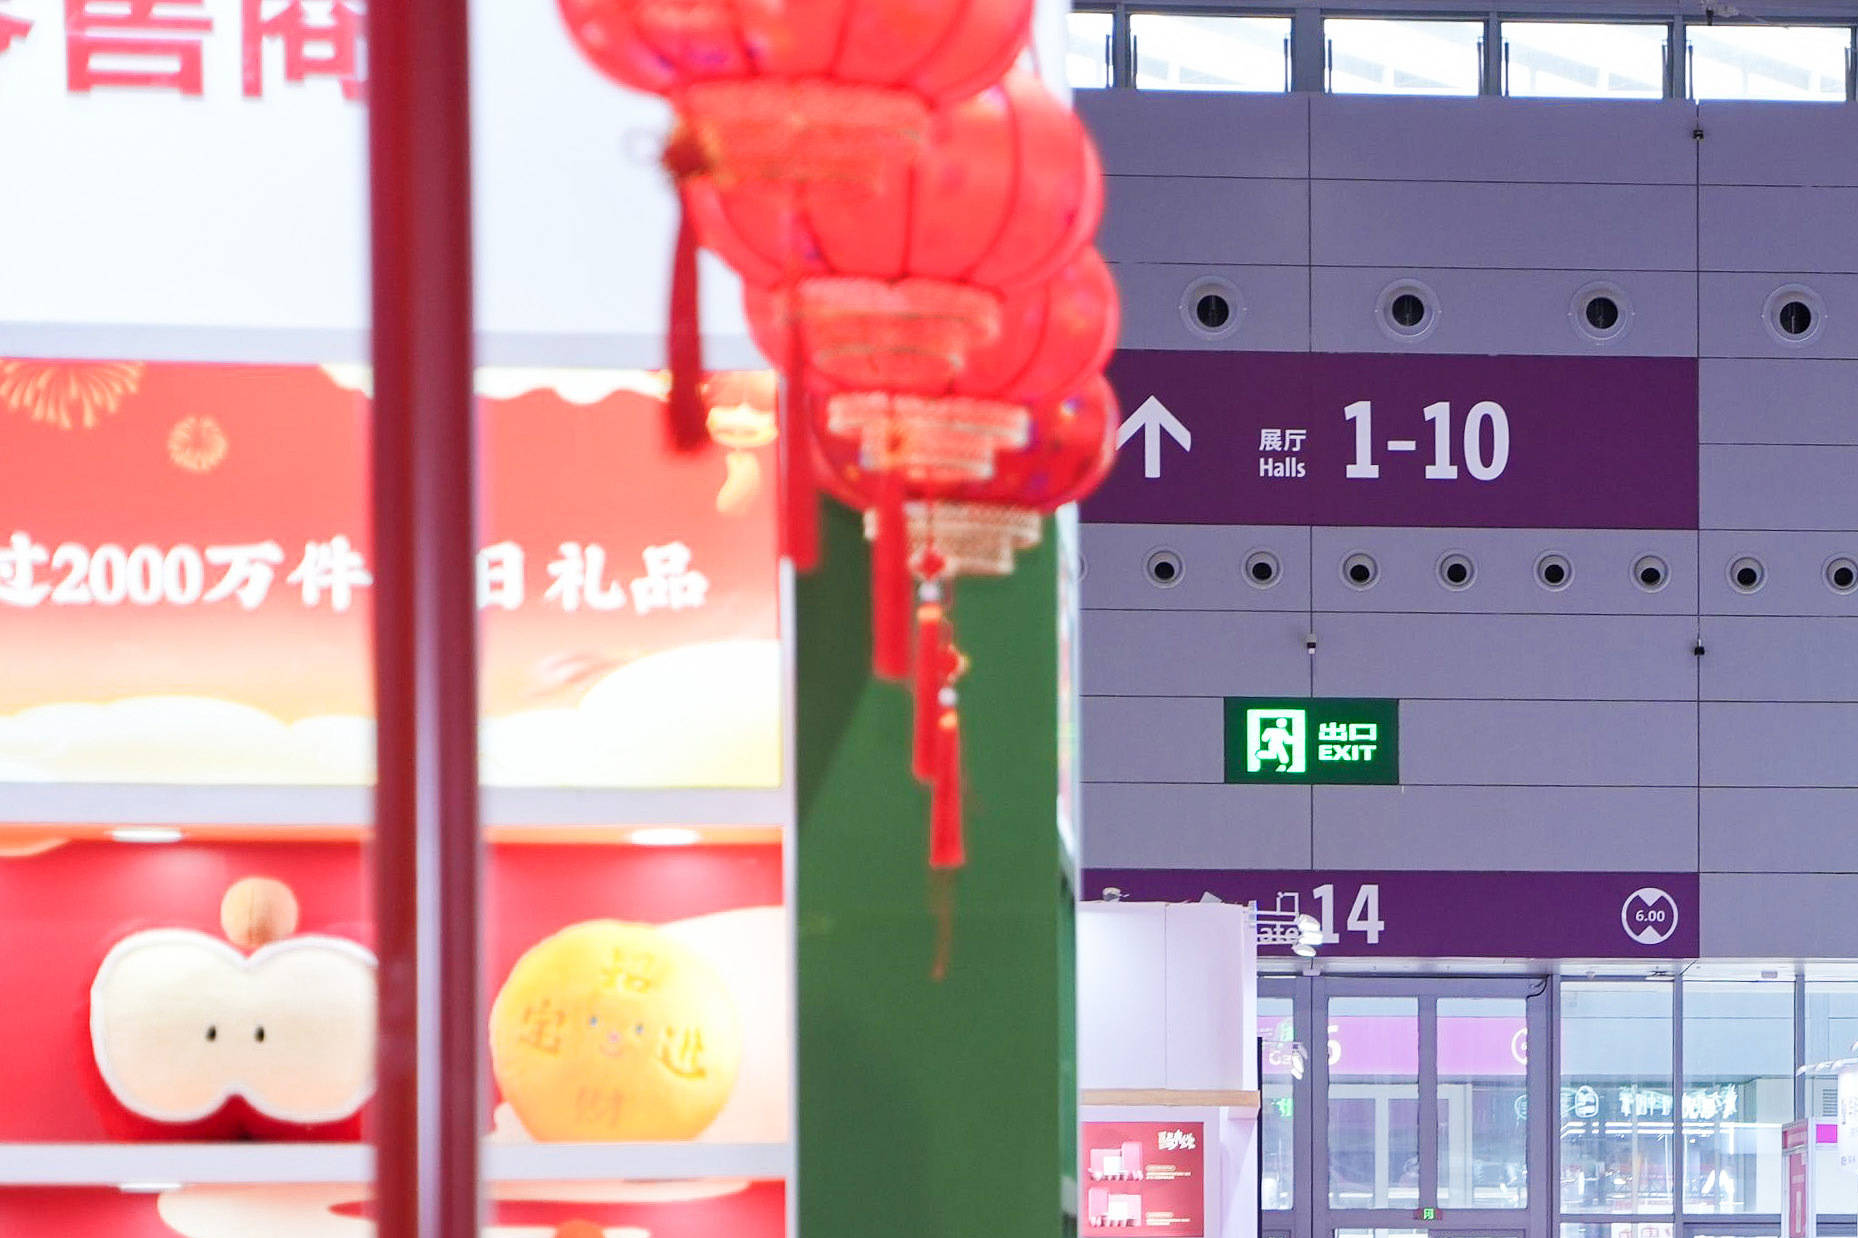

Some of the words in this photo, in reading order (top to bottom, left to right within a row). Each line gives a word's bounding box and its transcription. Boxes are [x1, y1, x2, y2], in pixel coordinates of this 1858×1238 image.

[1259, 428, 1308, 451] 展厅
[1343, 400, 1511, 481] 1-10
[1259, 456, 1307, 478] Halls
[1318, 721, 1378, 741] 出口
[1318, 744, 1378, 761] EXIT
[1312, 884, 1385, 944] 14
[1635, 910, 1666, 922] 6.00
